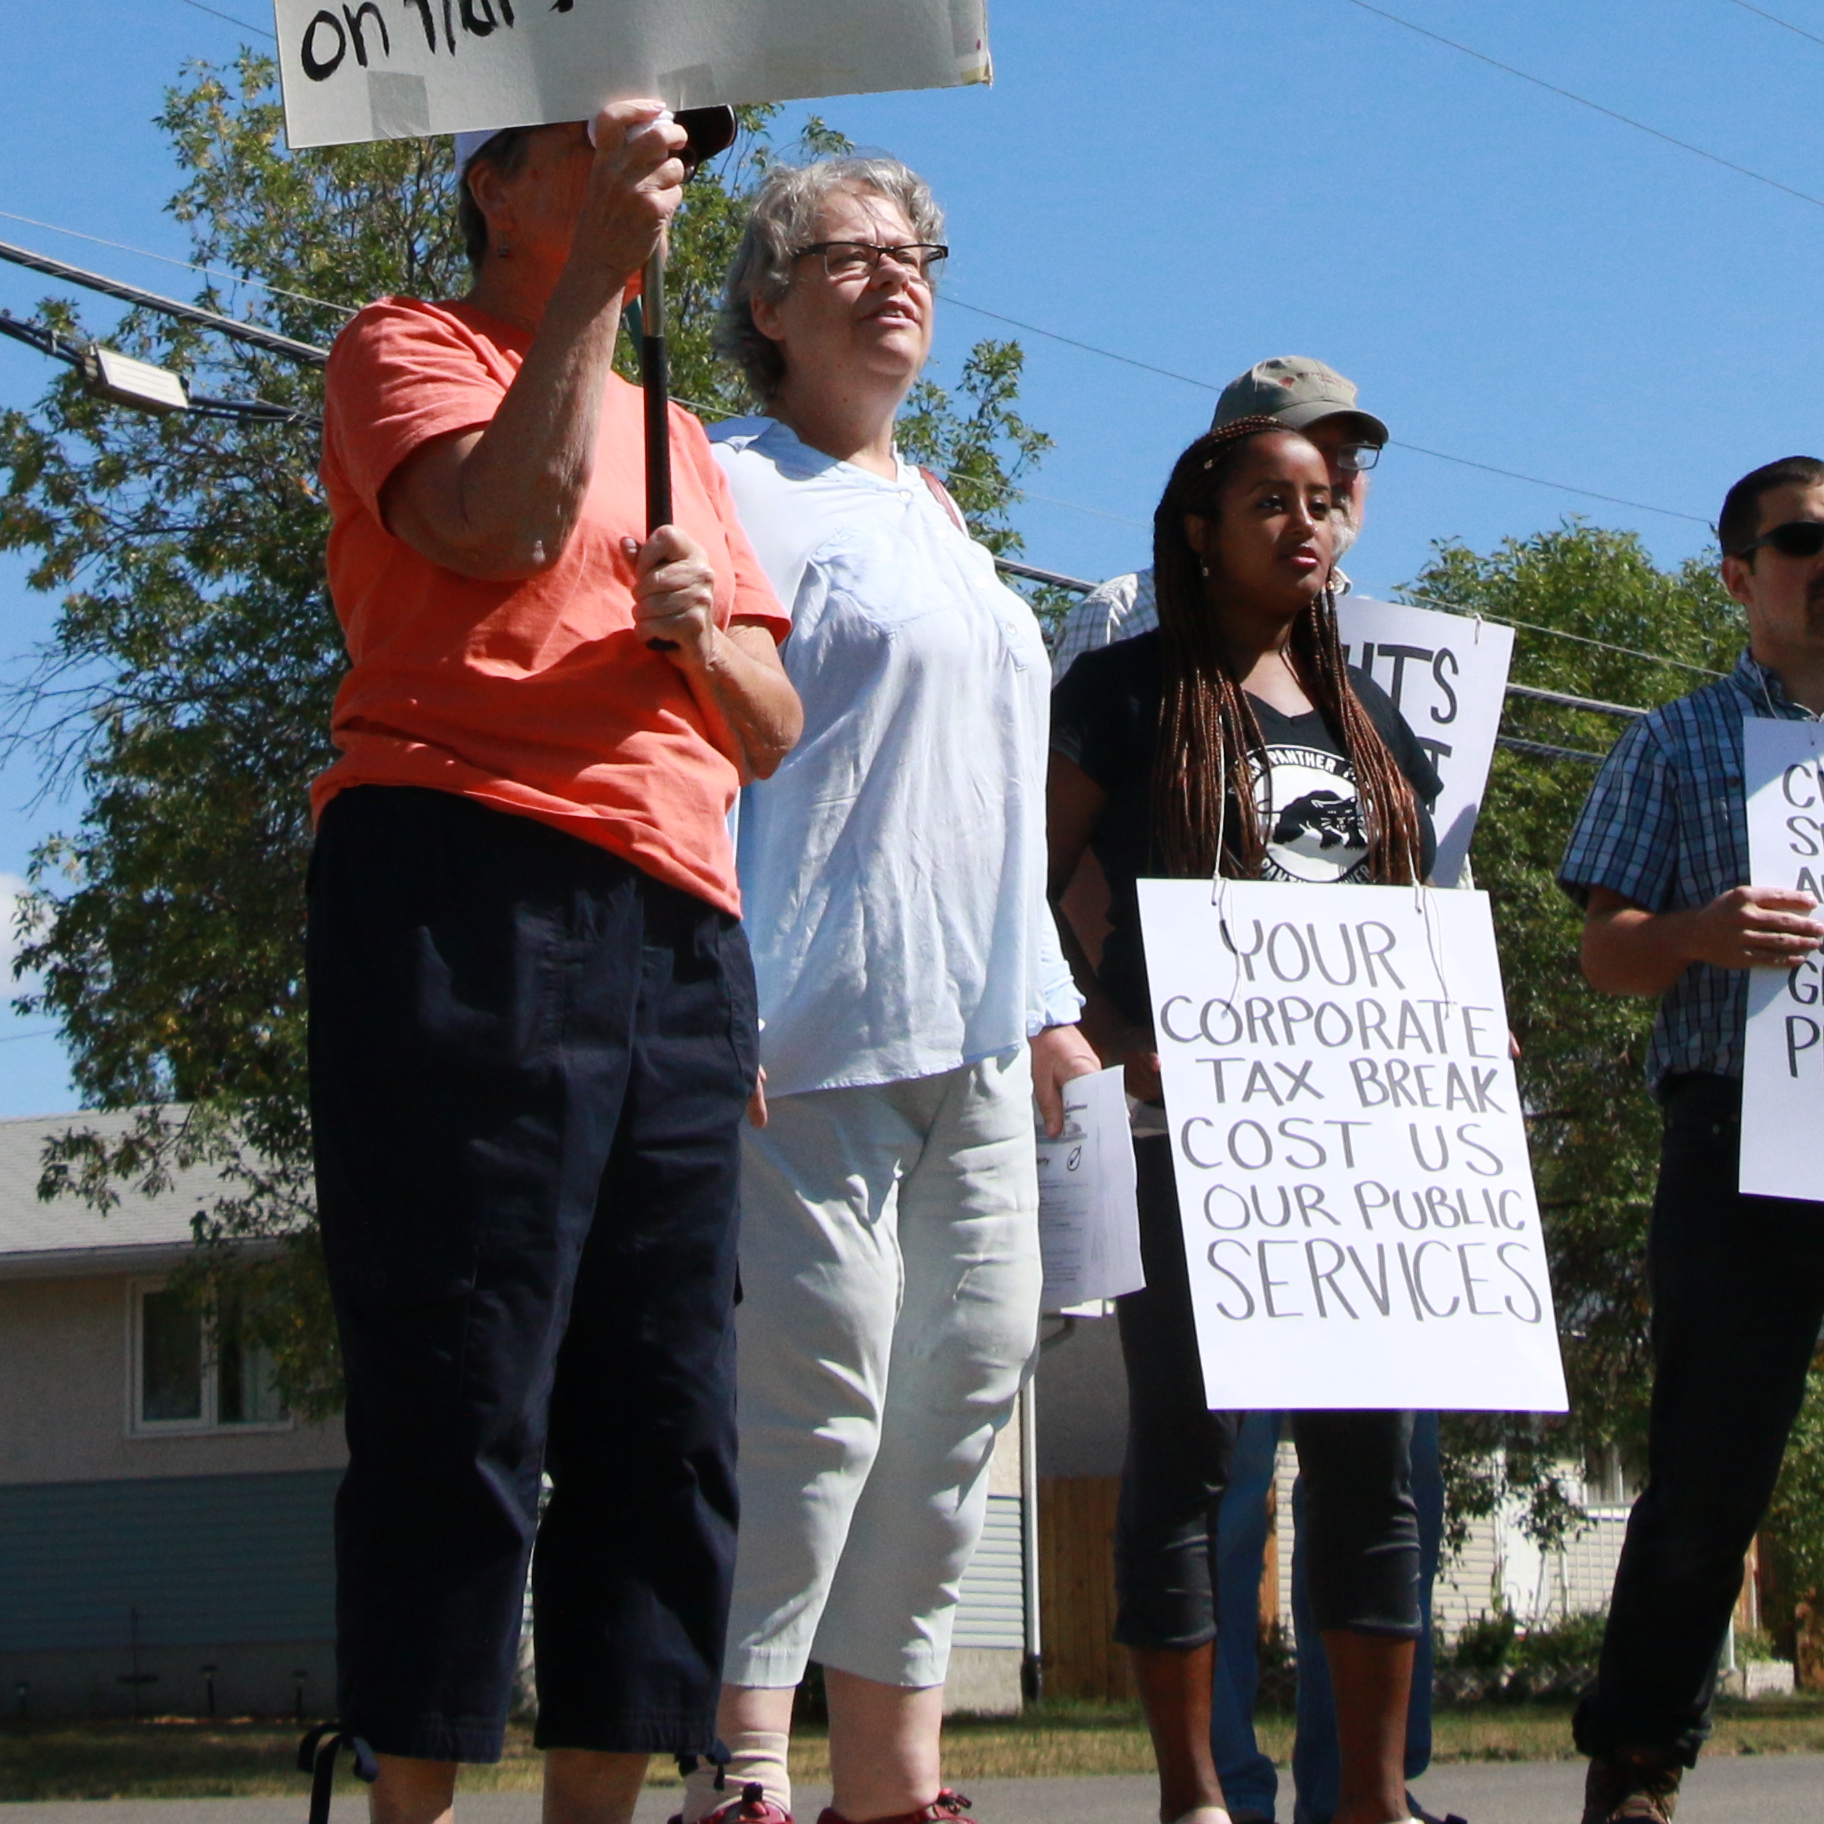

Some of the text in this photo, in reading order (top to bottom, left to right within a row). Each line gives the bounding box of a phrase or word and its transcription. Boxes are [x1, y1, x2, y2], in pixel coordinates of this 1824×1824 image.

[301, 1, 390, 82] on
[1267, 749, 1337, 774] PANTHER
[1219, 918, 1406, 991] YOUR
[1159, 993, 1498, 1060] CORPORATE
[1196, 1057, 1508, 1117] TAX BREAK
[1180, 1115, 1505, 1177] COST US
[1203, 1180, 1528, 1234] OUR PUBLIC
[1206, 1238, 1544, 1324] SERVICES
